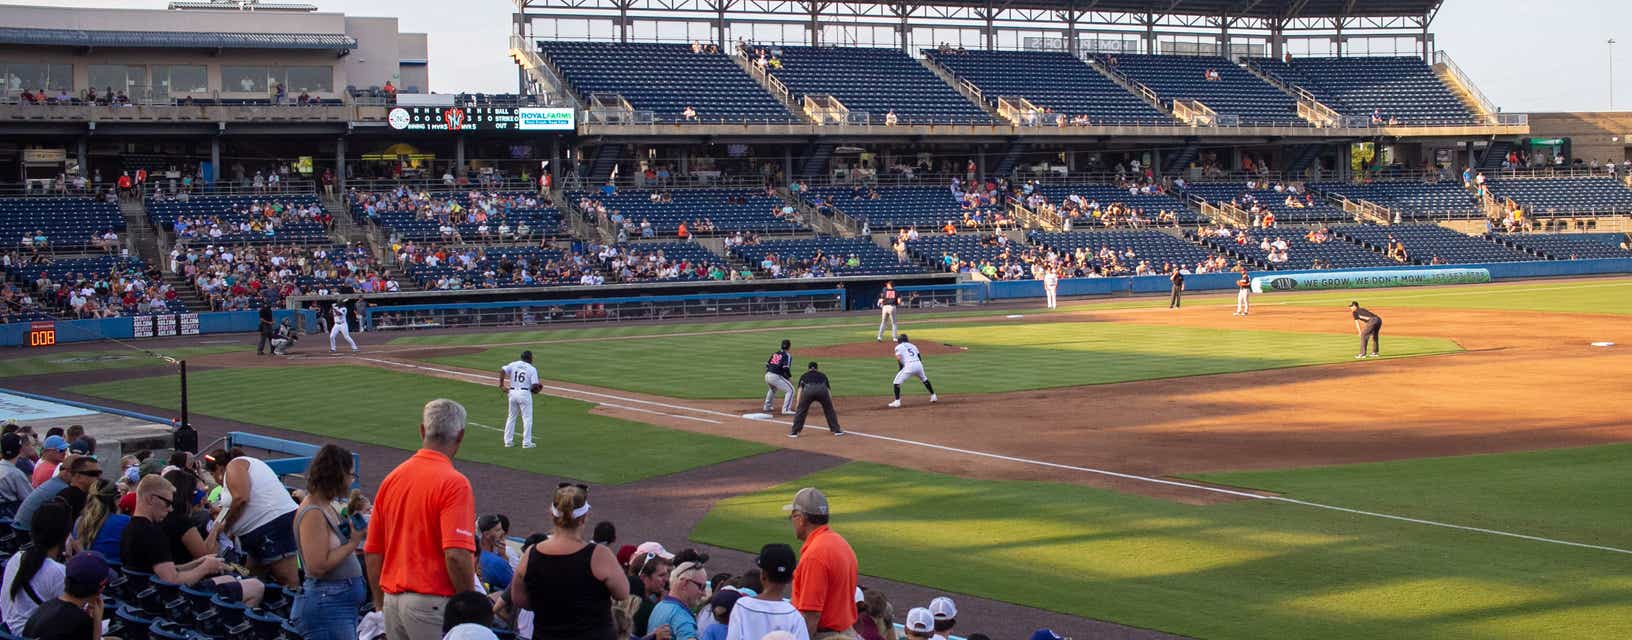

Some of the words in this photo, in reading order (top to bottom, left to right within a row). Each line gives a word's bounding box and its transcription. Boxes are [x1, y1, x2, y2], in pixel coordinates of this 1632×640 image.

[1304, 279, 1318, 288] WE
[1355, 276, 1368, 285] WE
[31, 330, 55, 346] 008
[907, 347, 915, 357] 5
[514, 371, 525, 383] 16
